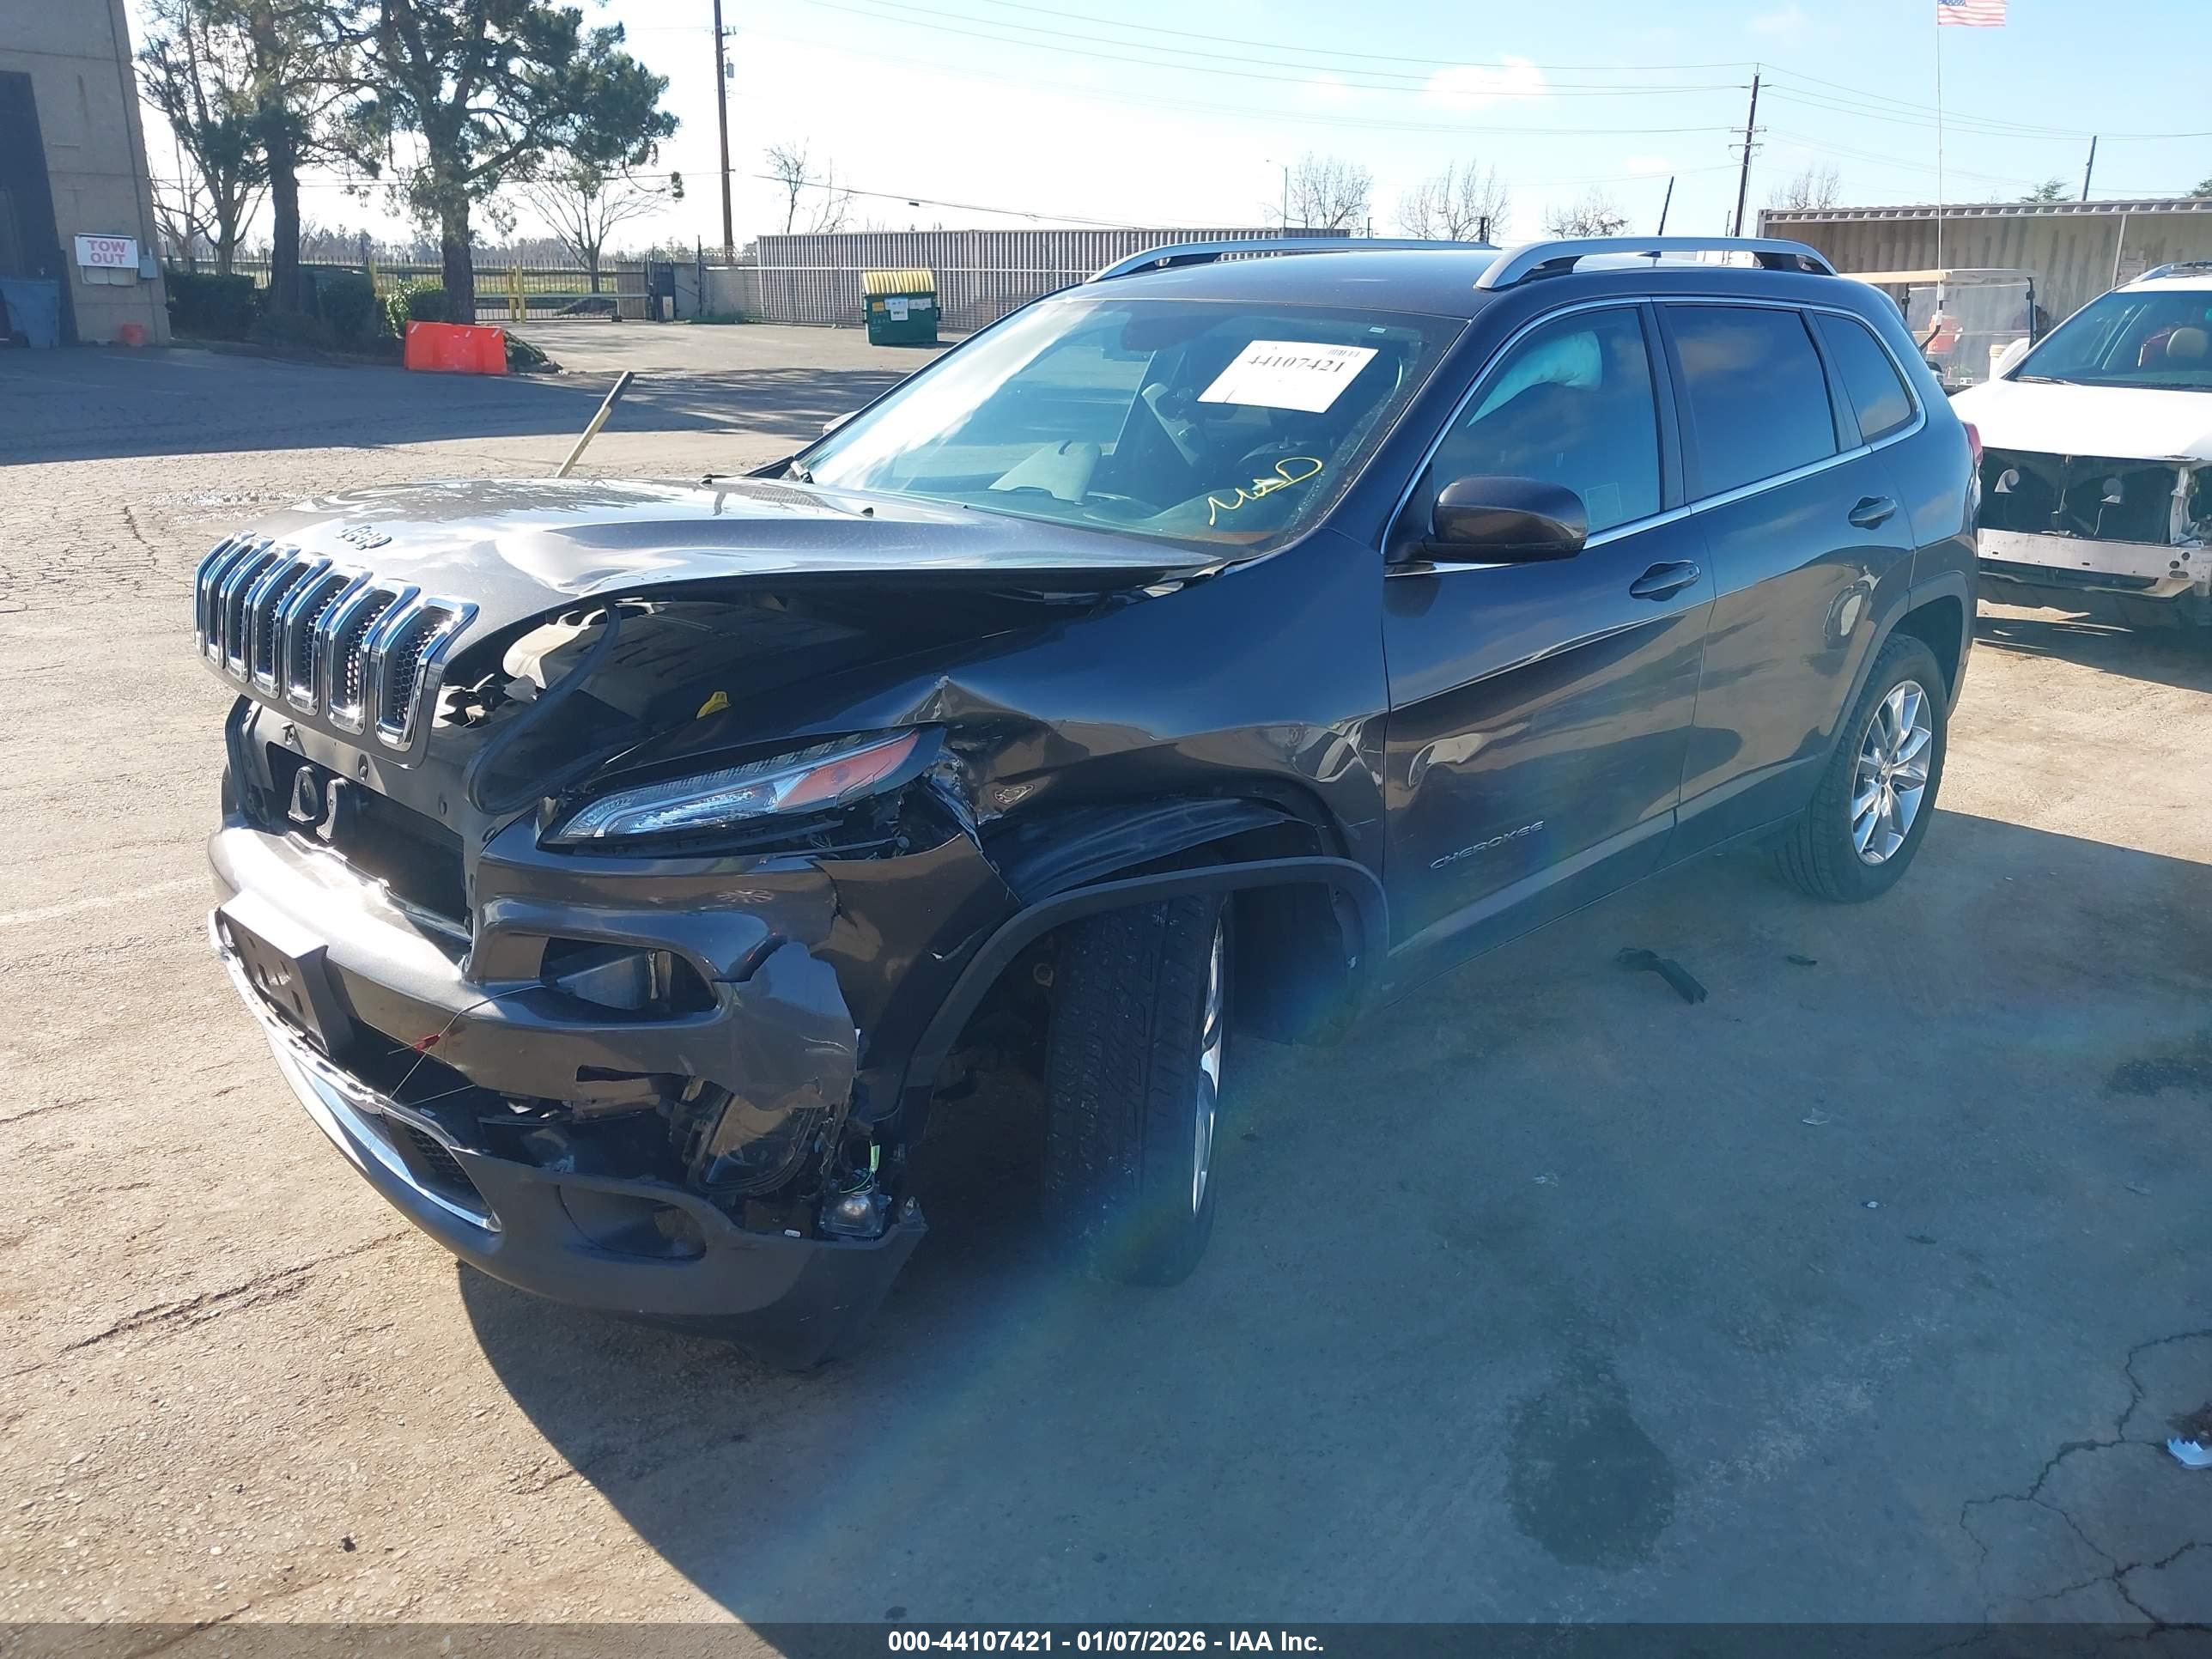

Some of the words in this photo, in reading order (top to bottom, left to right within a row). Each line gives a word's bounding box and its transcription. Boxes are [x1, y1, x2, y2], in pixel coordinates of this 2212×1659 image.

[88, 240, 125, 252] TOW
[90, 252, 125, 264] OUT
[1248, 356, 1345, 373] 44107421
[1430, 820, 1544, 869] CHEROKEE
